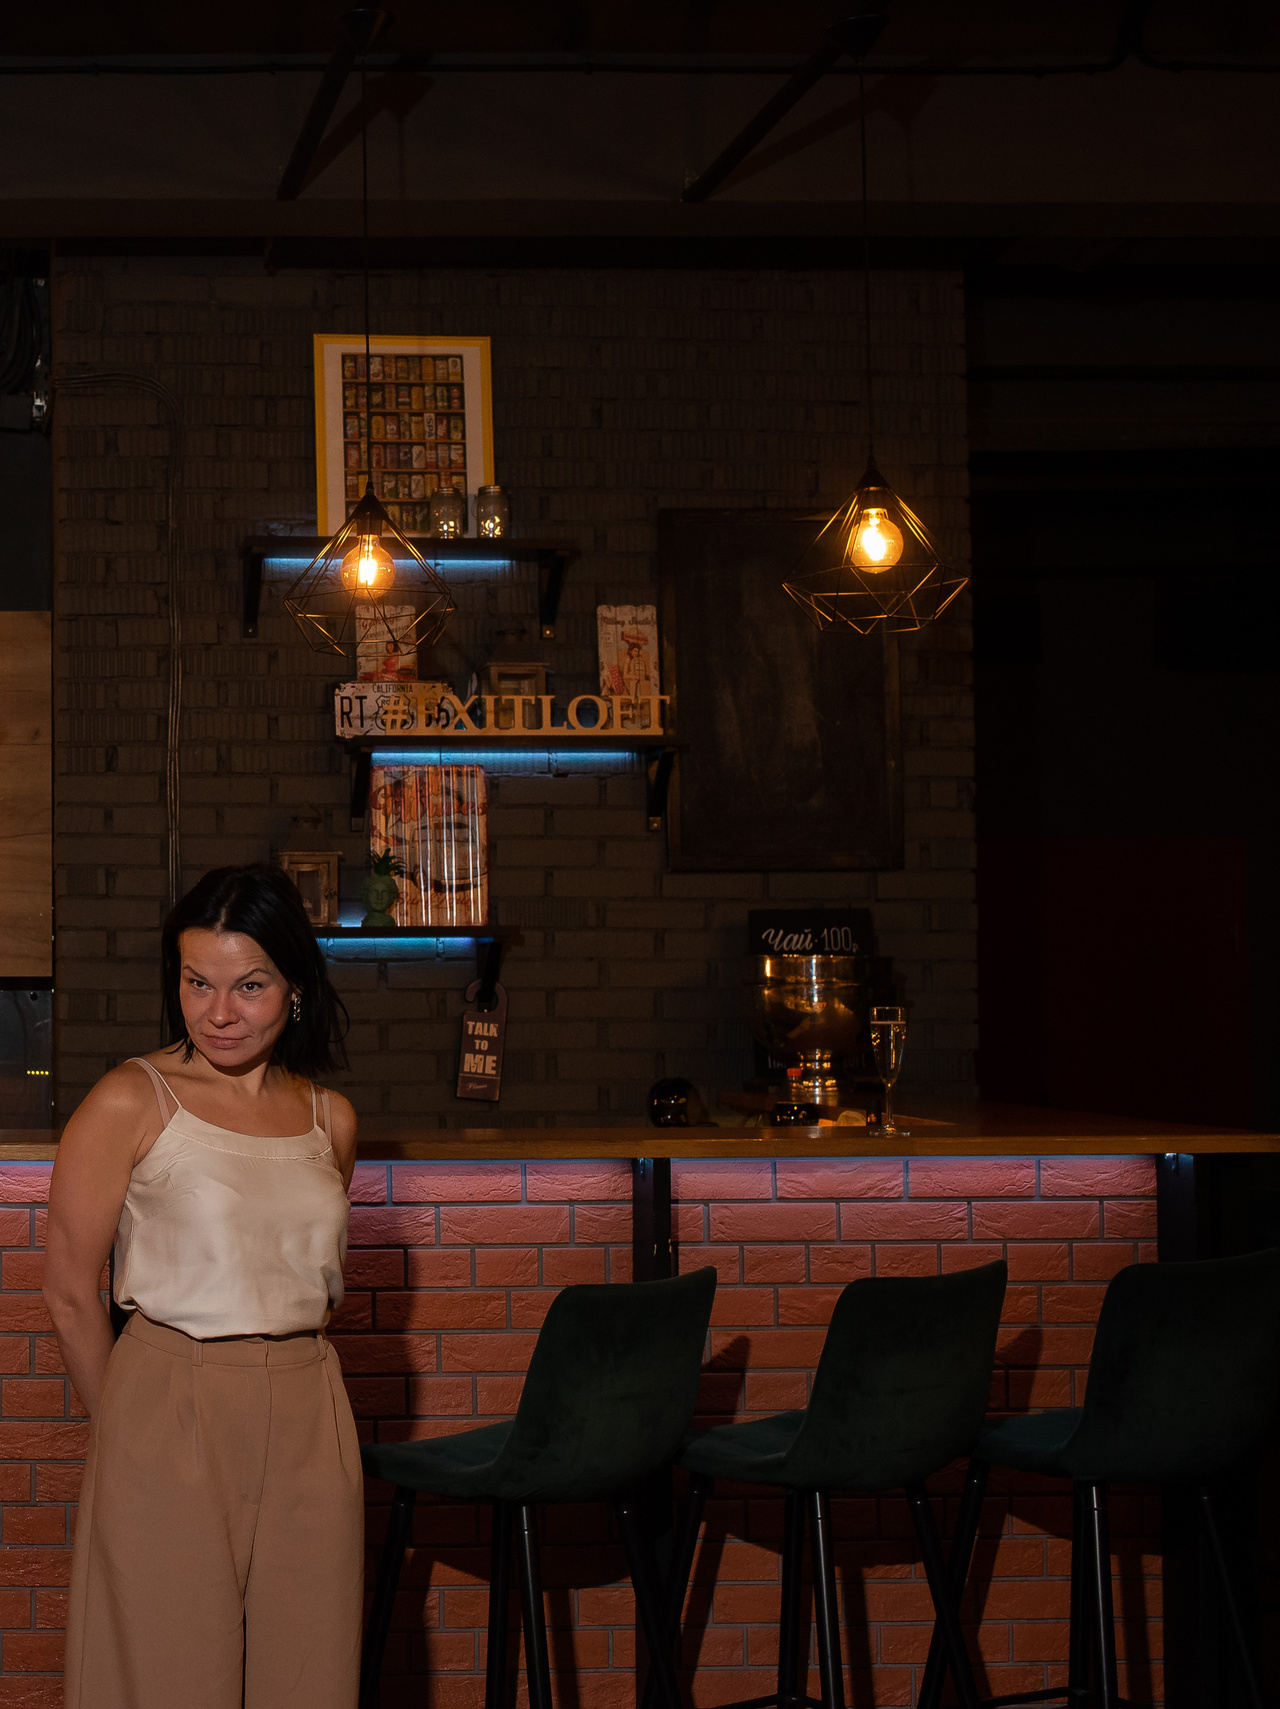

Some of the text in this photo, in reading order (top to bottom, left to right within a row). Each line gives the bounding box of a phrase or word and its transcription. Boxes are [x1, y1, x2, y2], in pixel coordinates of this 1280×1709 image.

[372, 683, 414, 694] CALIFORNIA
[340, 695, 368, 728] RT
[761, 927, 814, 952] Чай
[466, 1021, 499, 1037] TALK
[474, 1039, 489, 1051] TO
[463, 1053, 497, 1075] ME
